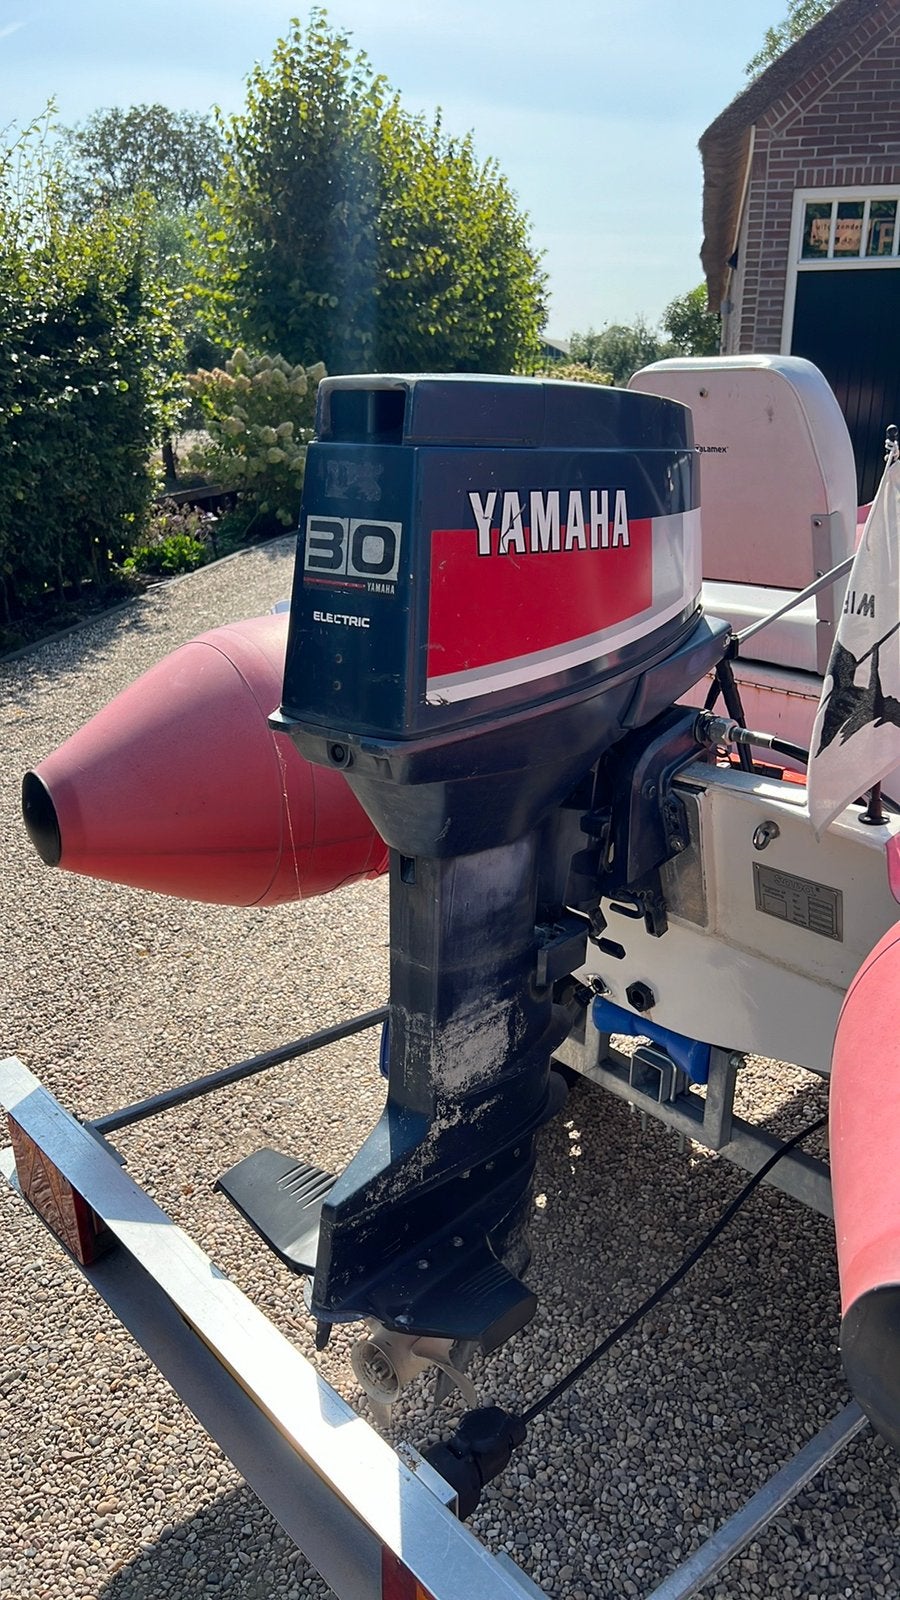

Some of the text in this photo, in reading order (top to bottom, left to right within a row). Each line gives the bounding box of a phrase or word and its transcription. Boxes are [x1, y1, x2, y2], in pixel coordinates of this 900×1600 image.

[467, 489, 630, 556] YAMAHA
[307, 519, 397, 575] 30
[366, 582, 395, 595] YAMAHA
[313, 611, 371, 628] ELECTRIC
